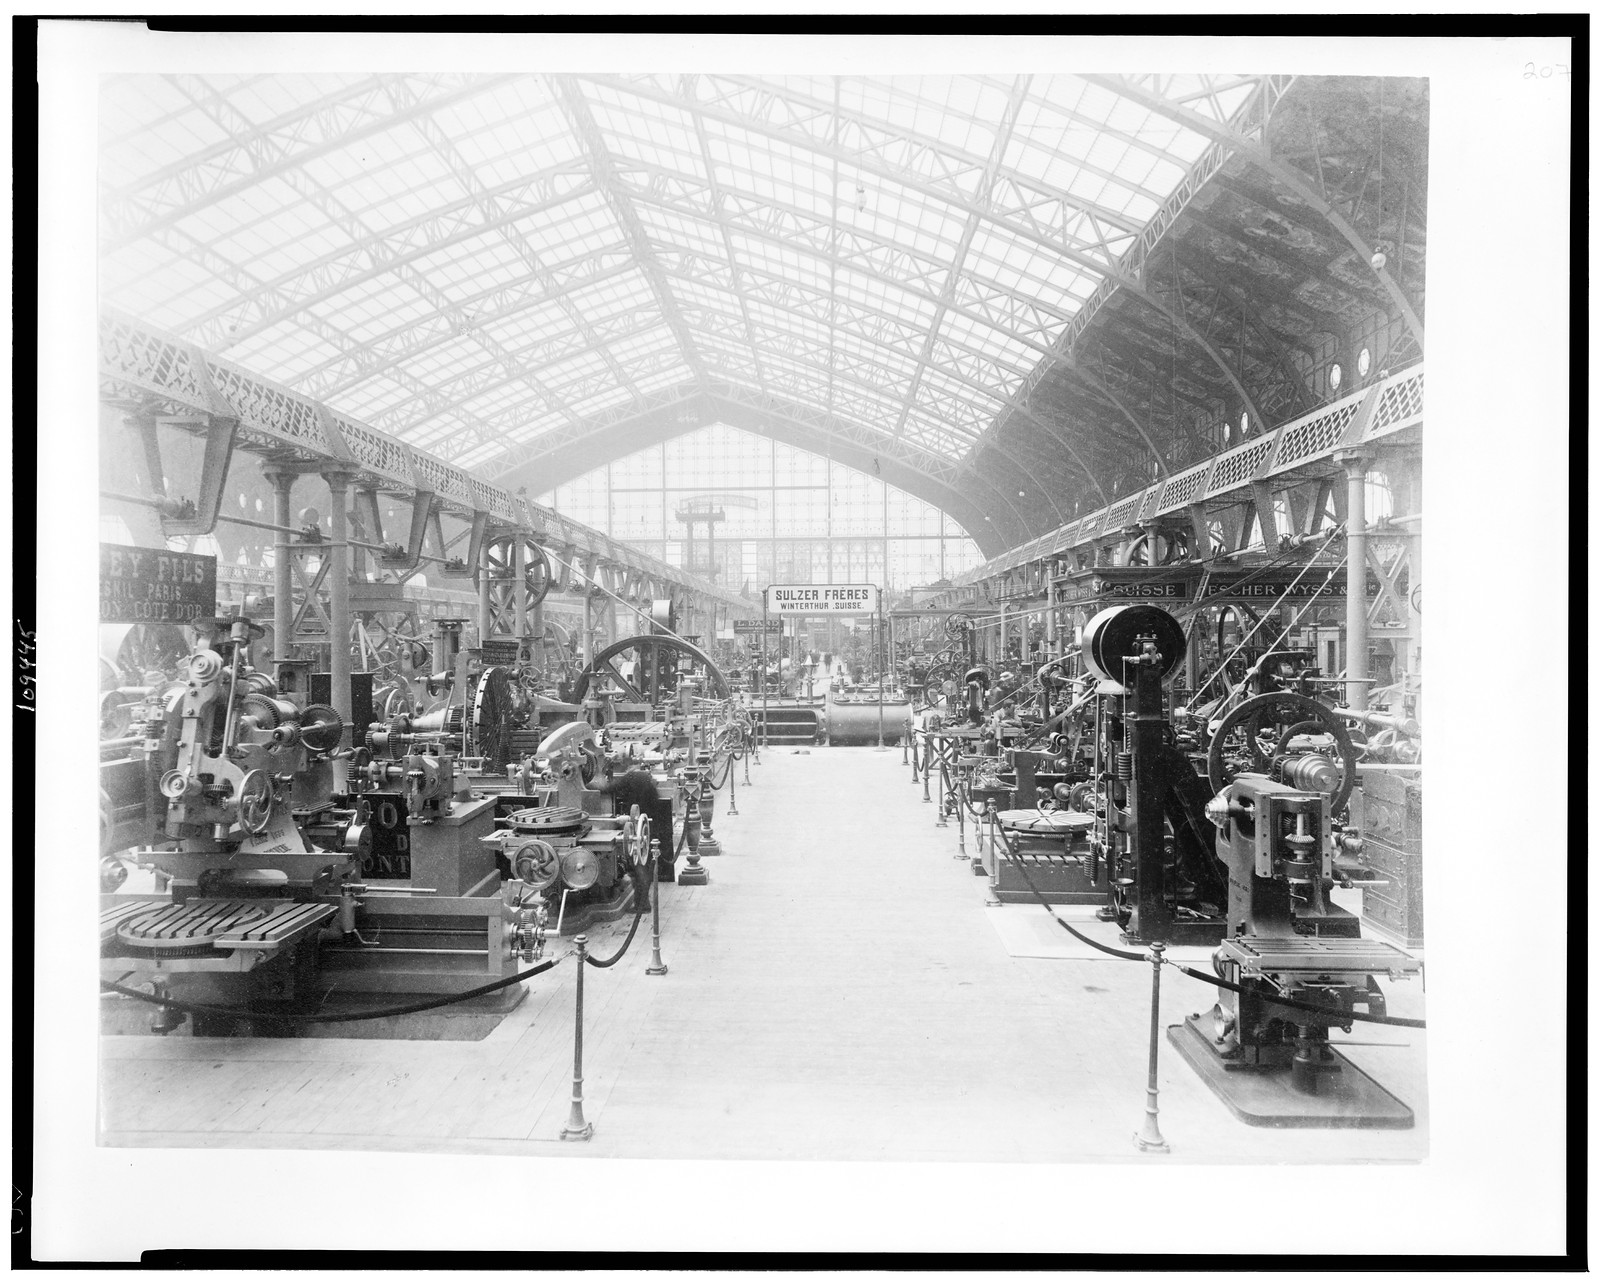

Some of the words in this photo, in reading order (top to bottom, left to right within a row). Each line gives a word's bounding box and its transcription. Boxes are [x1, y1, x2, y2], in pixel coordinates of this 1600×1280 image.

[157, 556, 204, 584] FILS
[148, 582, 182, 601] PARIS
[775, 590, 819, 600] SULZER
[1339, 585, 1348, 595] &
[780, 602, 829, 610] WINTERTHUR
[16, 618, 36, 712] 109445
